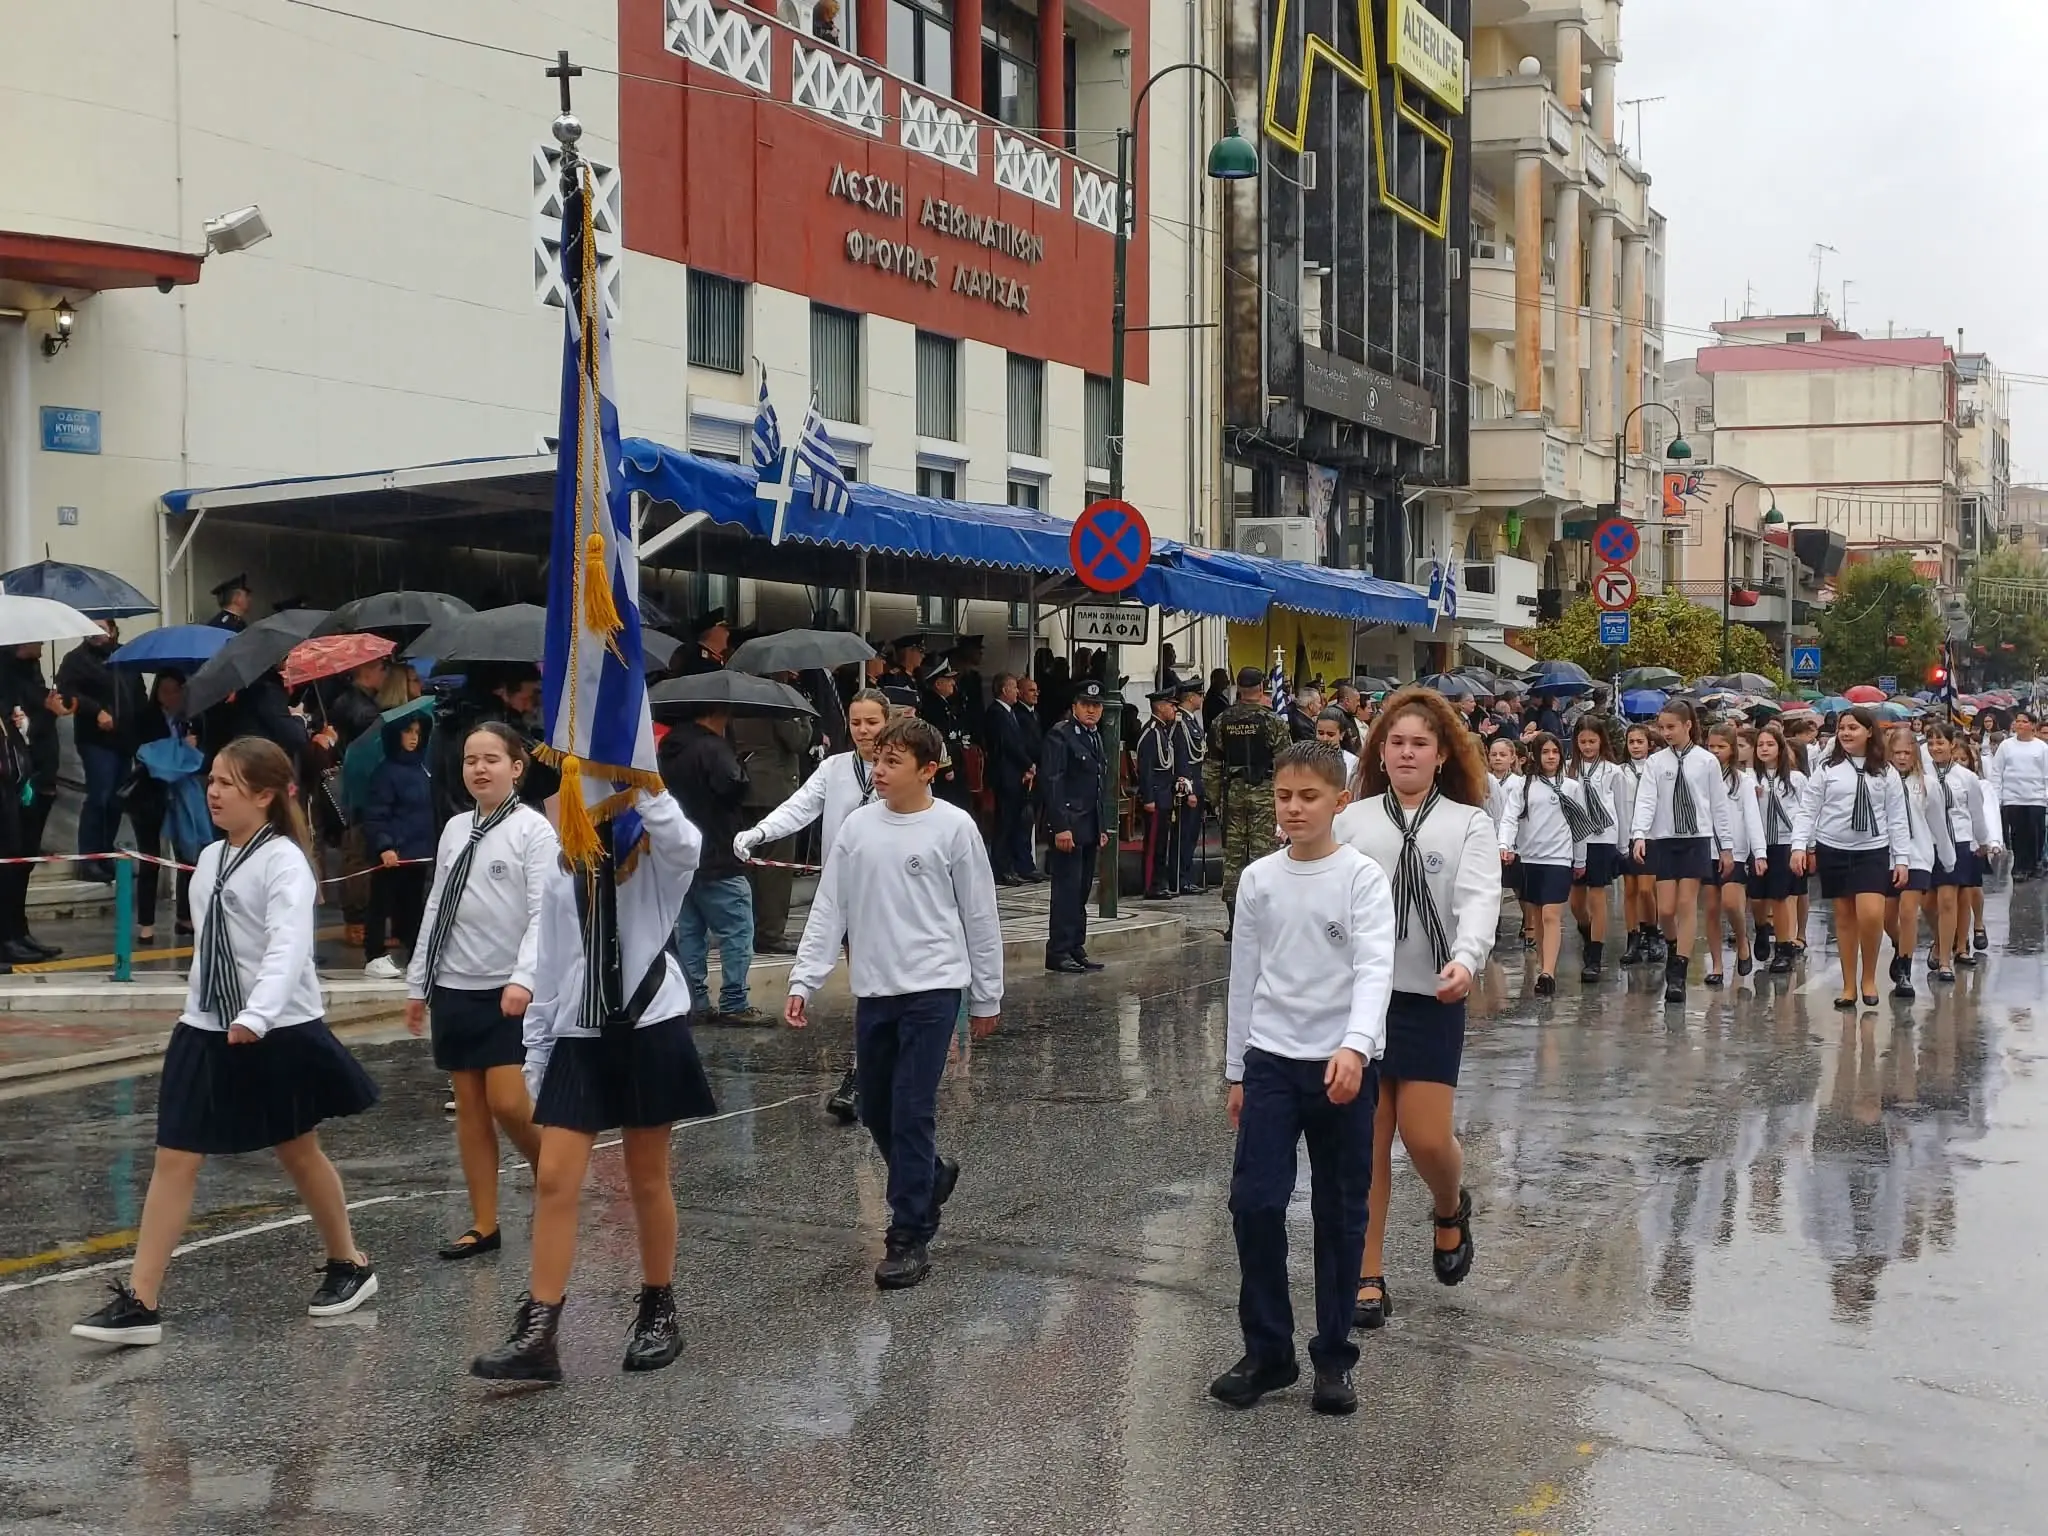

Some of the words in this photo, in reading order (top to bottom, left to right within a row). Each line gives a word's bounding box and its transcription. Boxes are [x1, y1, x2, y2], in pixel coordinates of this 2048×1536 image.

[1403, 5, 1458, 80] ALTERLIFE
[829, 160, 904, 217] ΛΕΣΧΗ
[920, 193, 1044, 265] ΑΞΙΩΜΑΤΙΚΩΝ
[846, 228, 939, 289] ΦΡΟΥΡΑΣ
[951, 262, 1031, 315] ΛΑΡΙΣΑΣ
[1077, 611, 1098, 620] ΠΛΗΝ
[1100, 612, 1141, 622] ΟΧΗΜΑΤΩΝ
[1226, 723, 1260, 731] MILITARY
